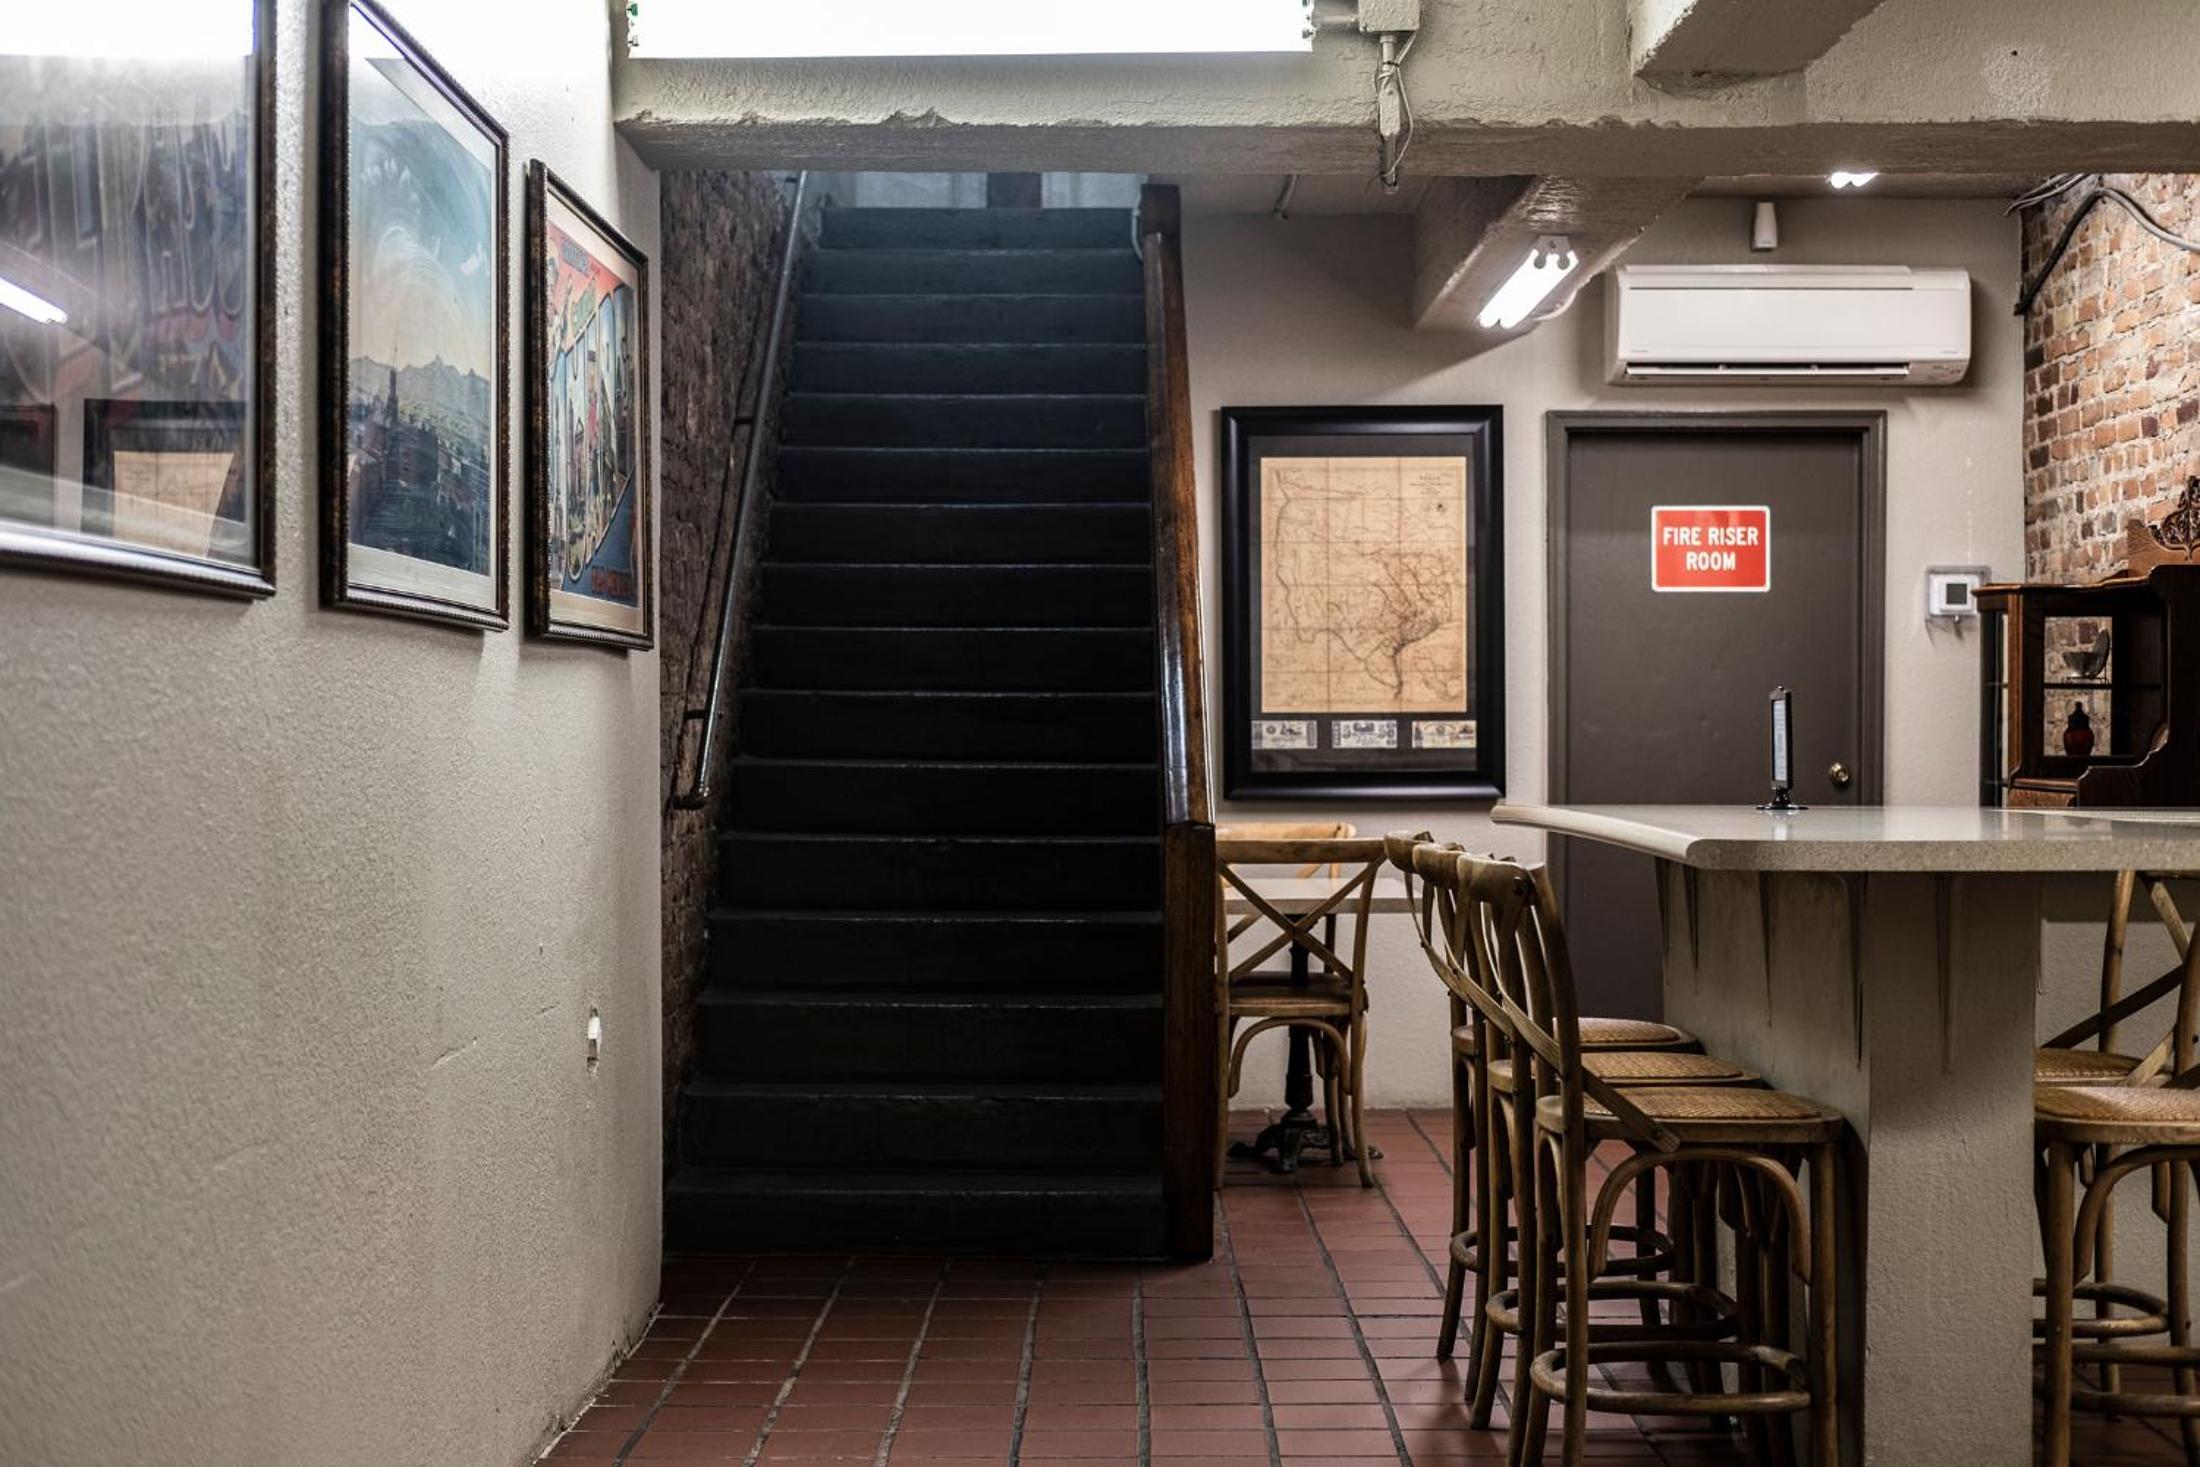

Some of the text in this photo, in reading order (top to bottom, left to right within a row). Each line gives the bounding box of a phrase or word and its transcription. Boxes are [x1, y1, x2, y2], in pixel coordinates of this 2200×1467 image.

[1663, 527, 1759, 546] FIRE RISER
[1686, 552, 1736, 571] ROOM
